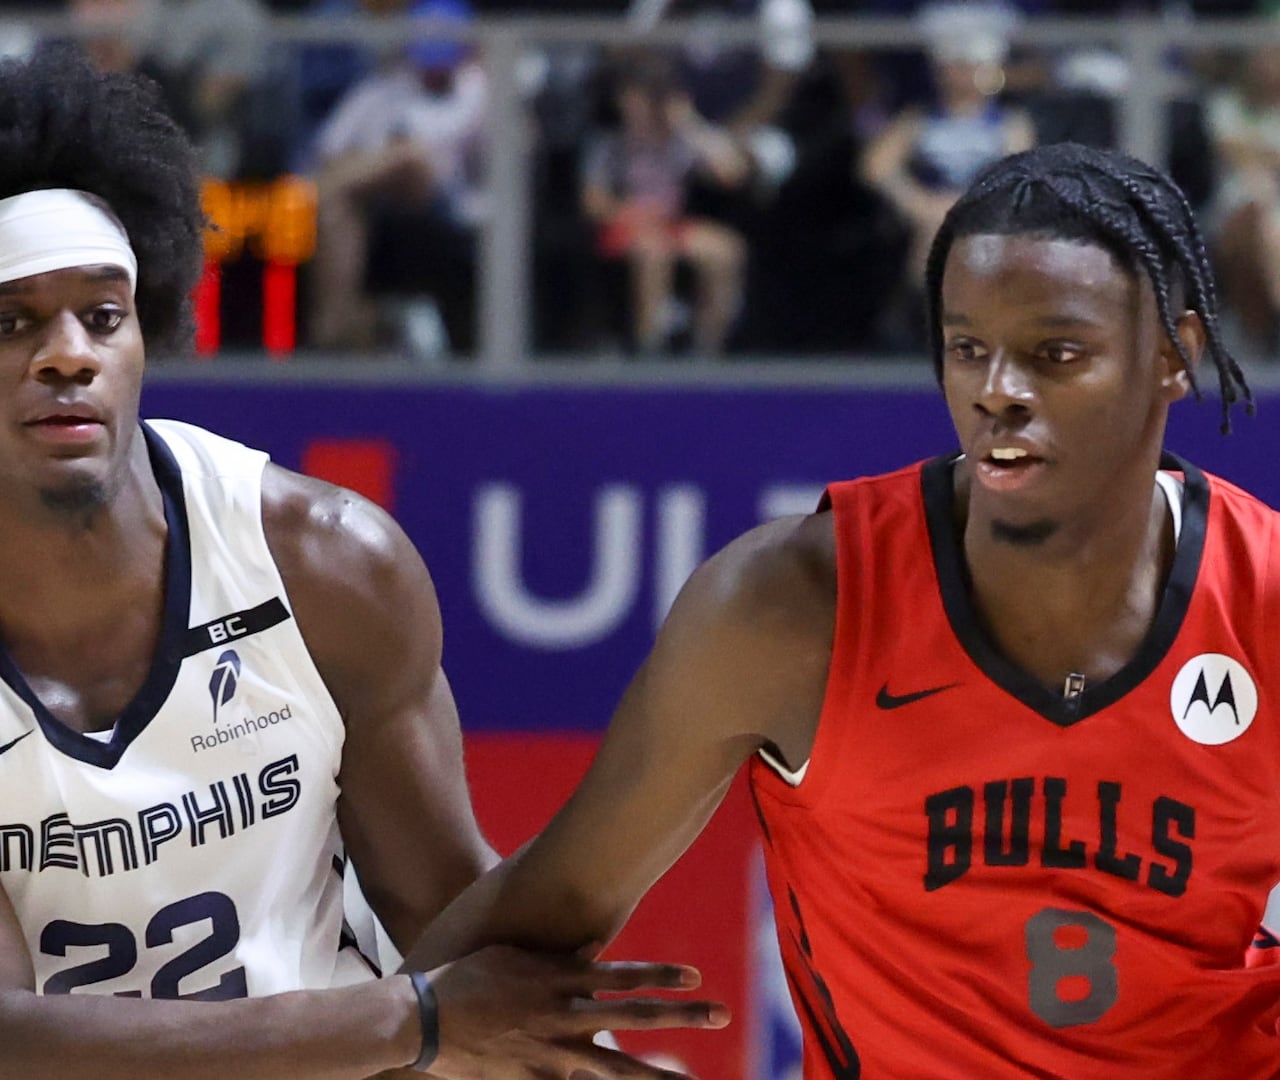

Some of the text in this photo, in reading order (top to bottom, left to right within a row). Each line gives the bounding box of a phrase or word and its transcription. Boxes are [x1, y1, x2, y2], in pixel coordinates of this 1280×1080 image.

[207, 615, 249, 645] BC
[190, 703, 293, 753] Robinhood
[923, 776, 1196, 898] BULLS
[39, 890, 249, 1001] 22
[1024, 906, 1119, 1029] 8
